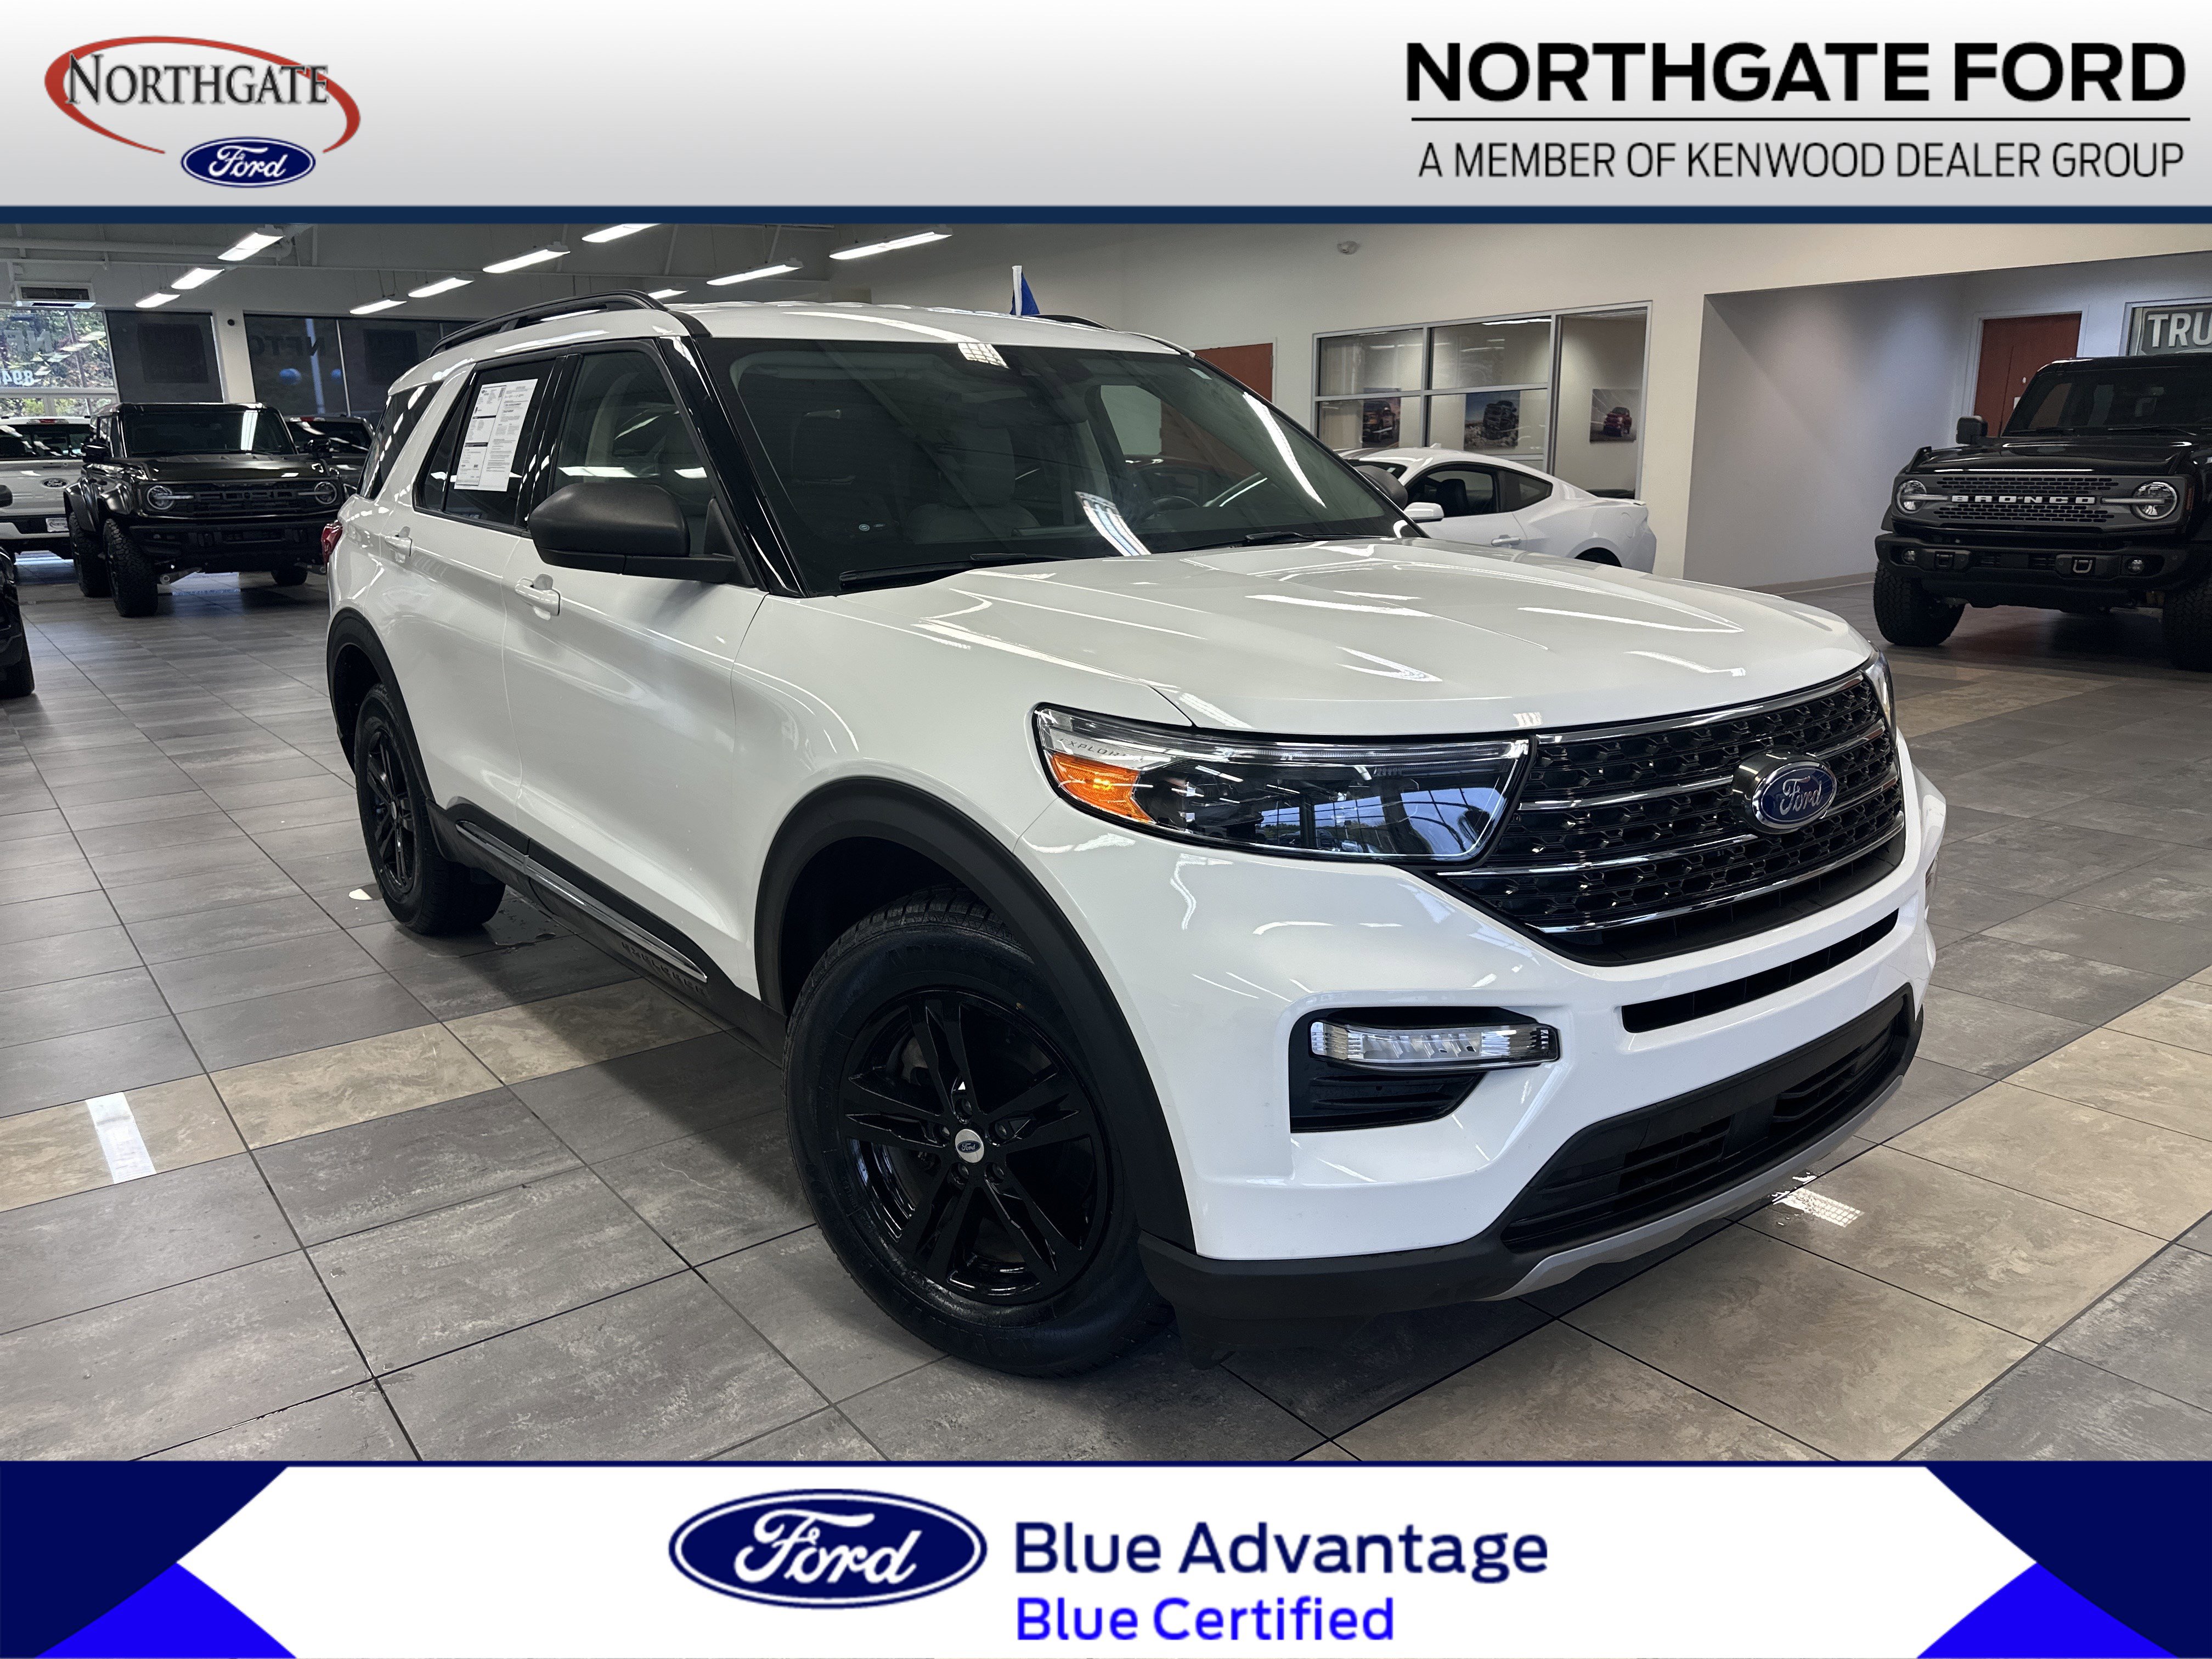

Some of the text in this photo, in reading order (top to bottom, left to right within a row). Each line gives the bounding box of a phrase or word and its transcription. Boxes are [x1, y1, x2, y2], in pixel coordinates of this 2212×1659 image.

[1951, 495, 2096, 504] BRONCO
[1060, 738, 1143, 763] XPLOR
[1779, 775, 1822, 816] Ford
[961, 1143, 975, 1151] Ford
